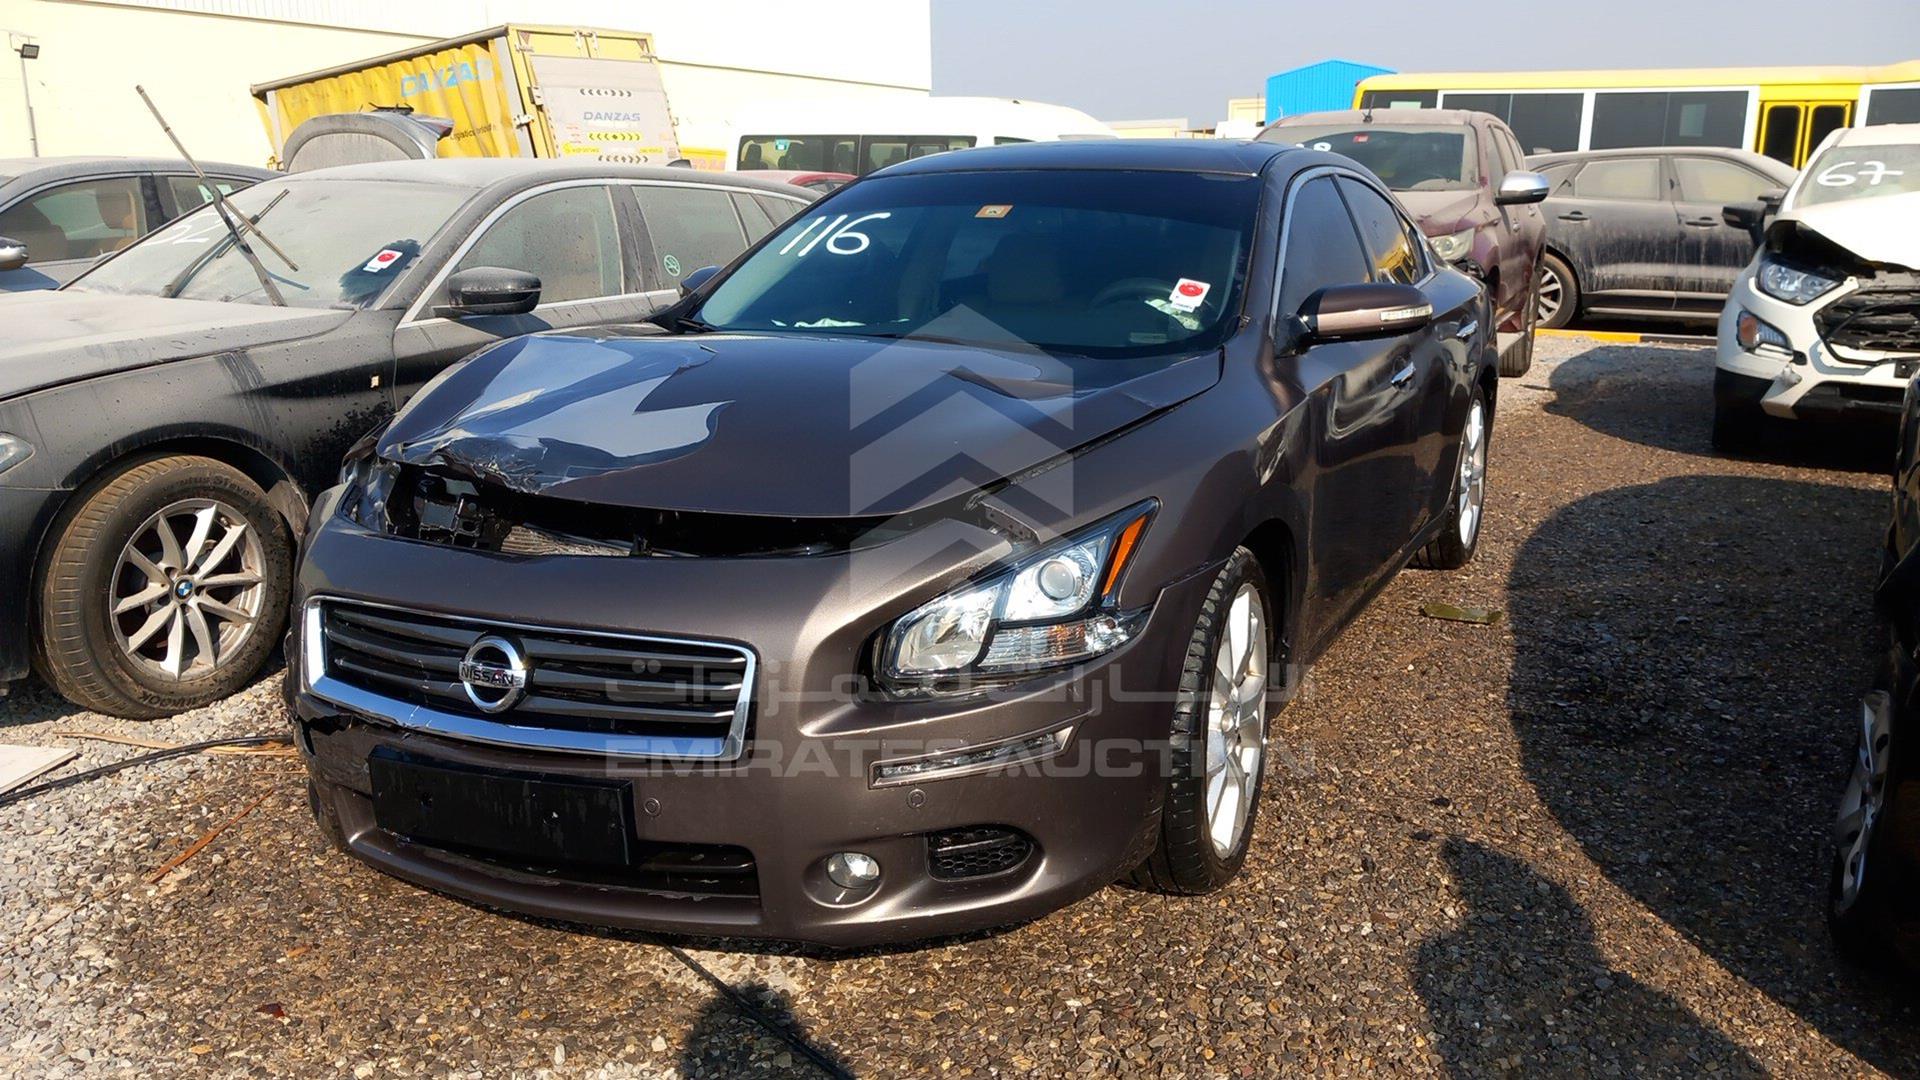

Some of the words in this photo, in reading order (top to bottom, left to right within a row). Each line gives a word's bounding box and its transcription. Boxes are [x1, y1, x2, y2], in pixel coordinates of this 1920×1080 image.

[583, 111, 641, 122] DANZAS
[1816, 160, 1904, 187] 67
[779, 212, 891, 257] 116
[461, 664, 515, 687] NISSAN
